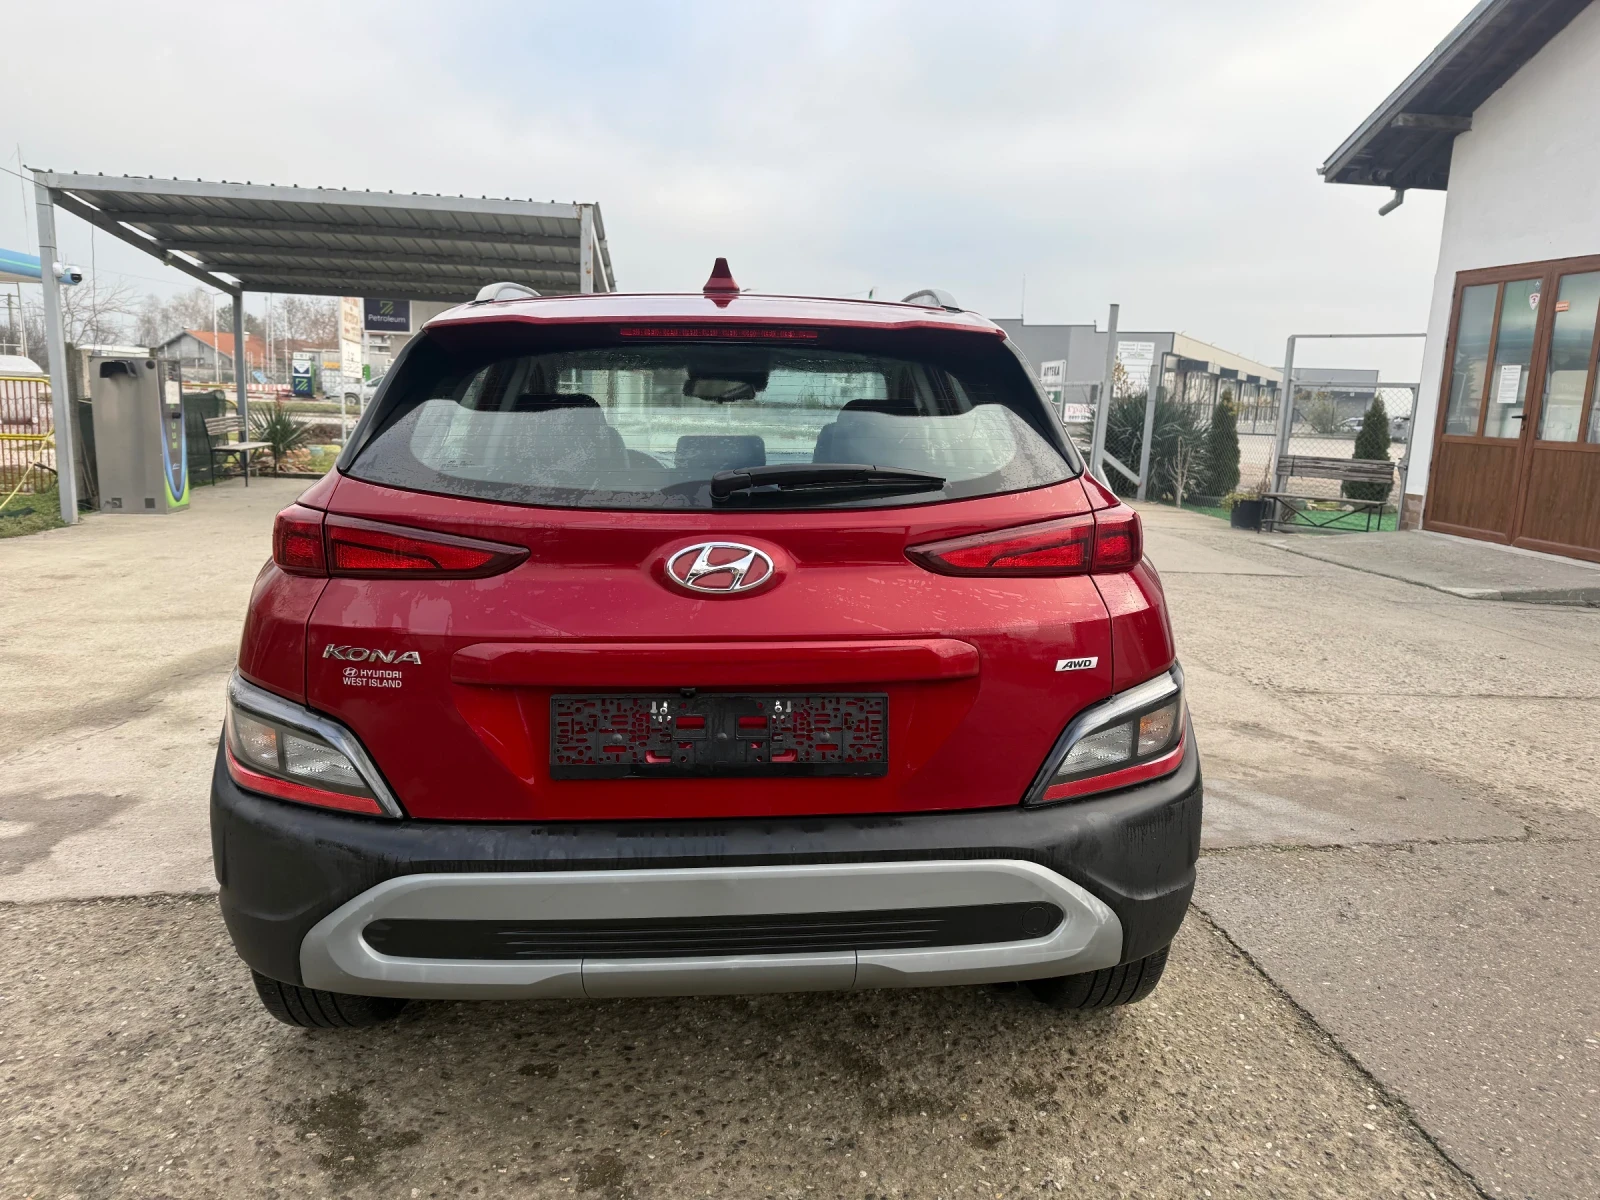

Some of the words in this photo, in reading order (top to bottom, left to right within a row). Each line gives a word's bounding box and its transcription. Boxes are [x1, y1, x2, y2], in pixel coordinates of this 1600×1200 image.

[368, 314, 406, 324] Petroleum
[322, 643, 422, 665] KONA
[1062, 659, 1092, 670] AWD
[360, 669, 402, 679] HYUNDAI
[343, 677, 367, 687] WEST
[369, 679, 402, 688] ISLAND
